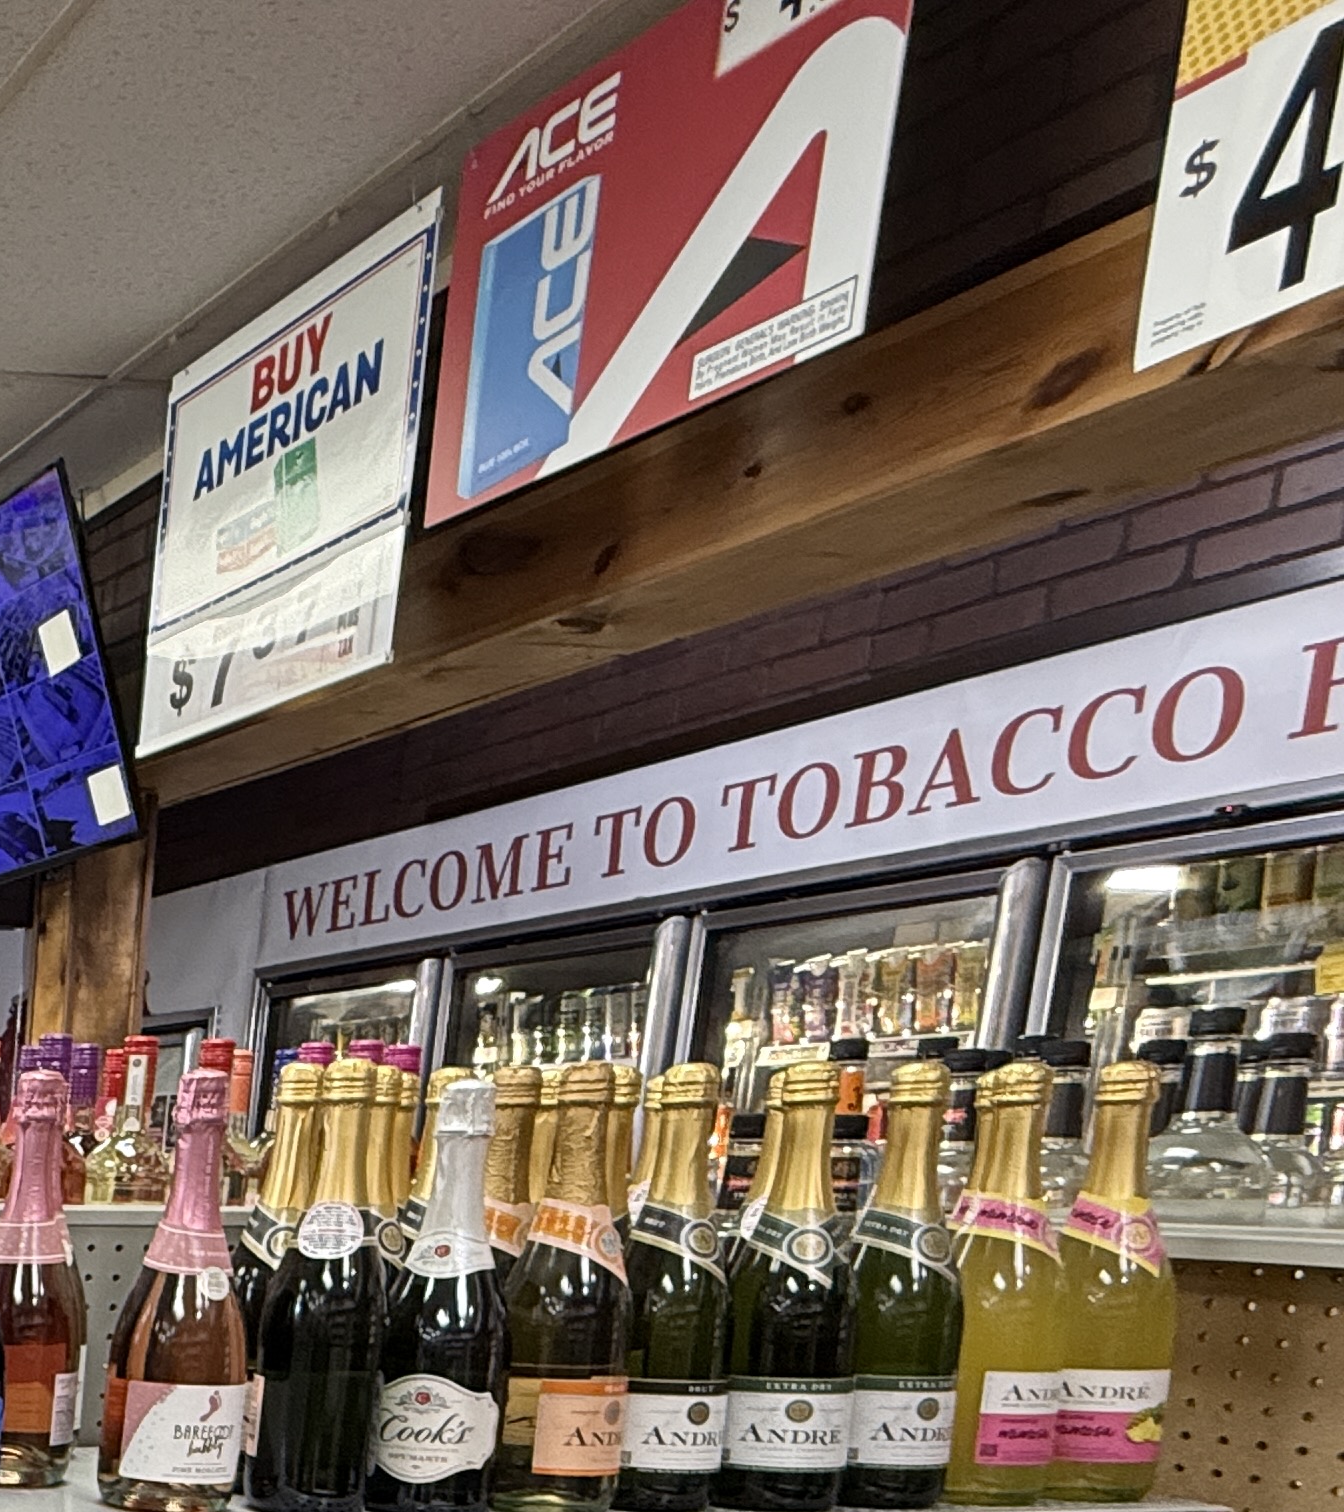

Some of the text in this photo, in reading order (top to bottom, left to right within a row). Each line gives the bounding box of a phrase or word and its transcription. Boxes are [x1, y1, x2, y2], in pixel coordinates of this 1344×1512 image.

[484, 131, 614, 220] FIND YOUR FLAVOR
[486, 71, 621, 205] ACE
[249, 311, 332, 414] BUY
[193, 338, 384, 501] AMERICAN
[284, 823, 575, 941] WELCOME
[595, 798, 697, 878] TO
[721, 666, 1249, 854] TOBACCO
[380, 1413, 474, 1445] Cook's
[736, 1423, 844, 1446] ANDRÉ
